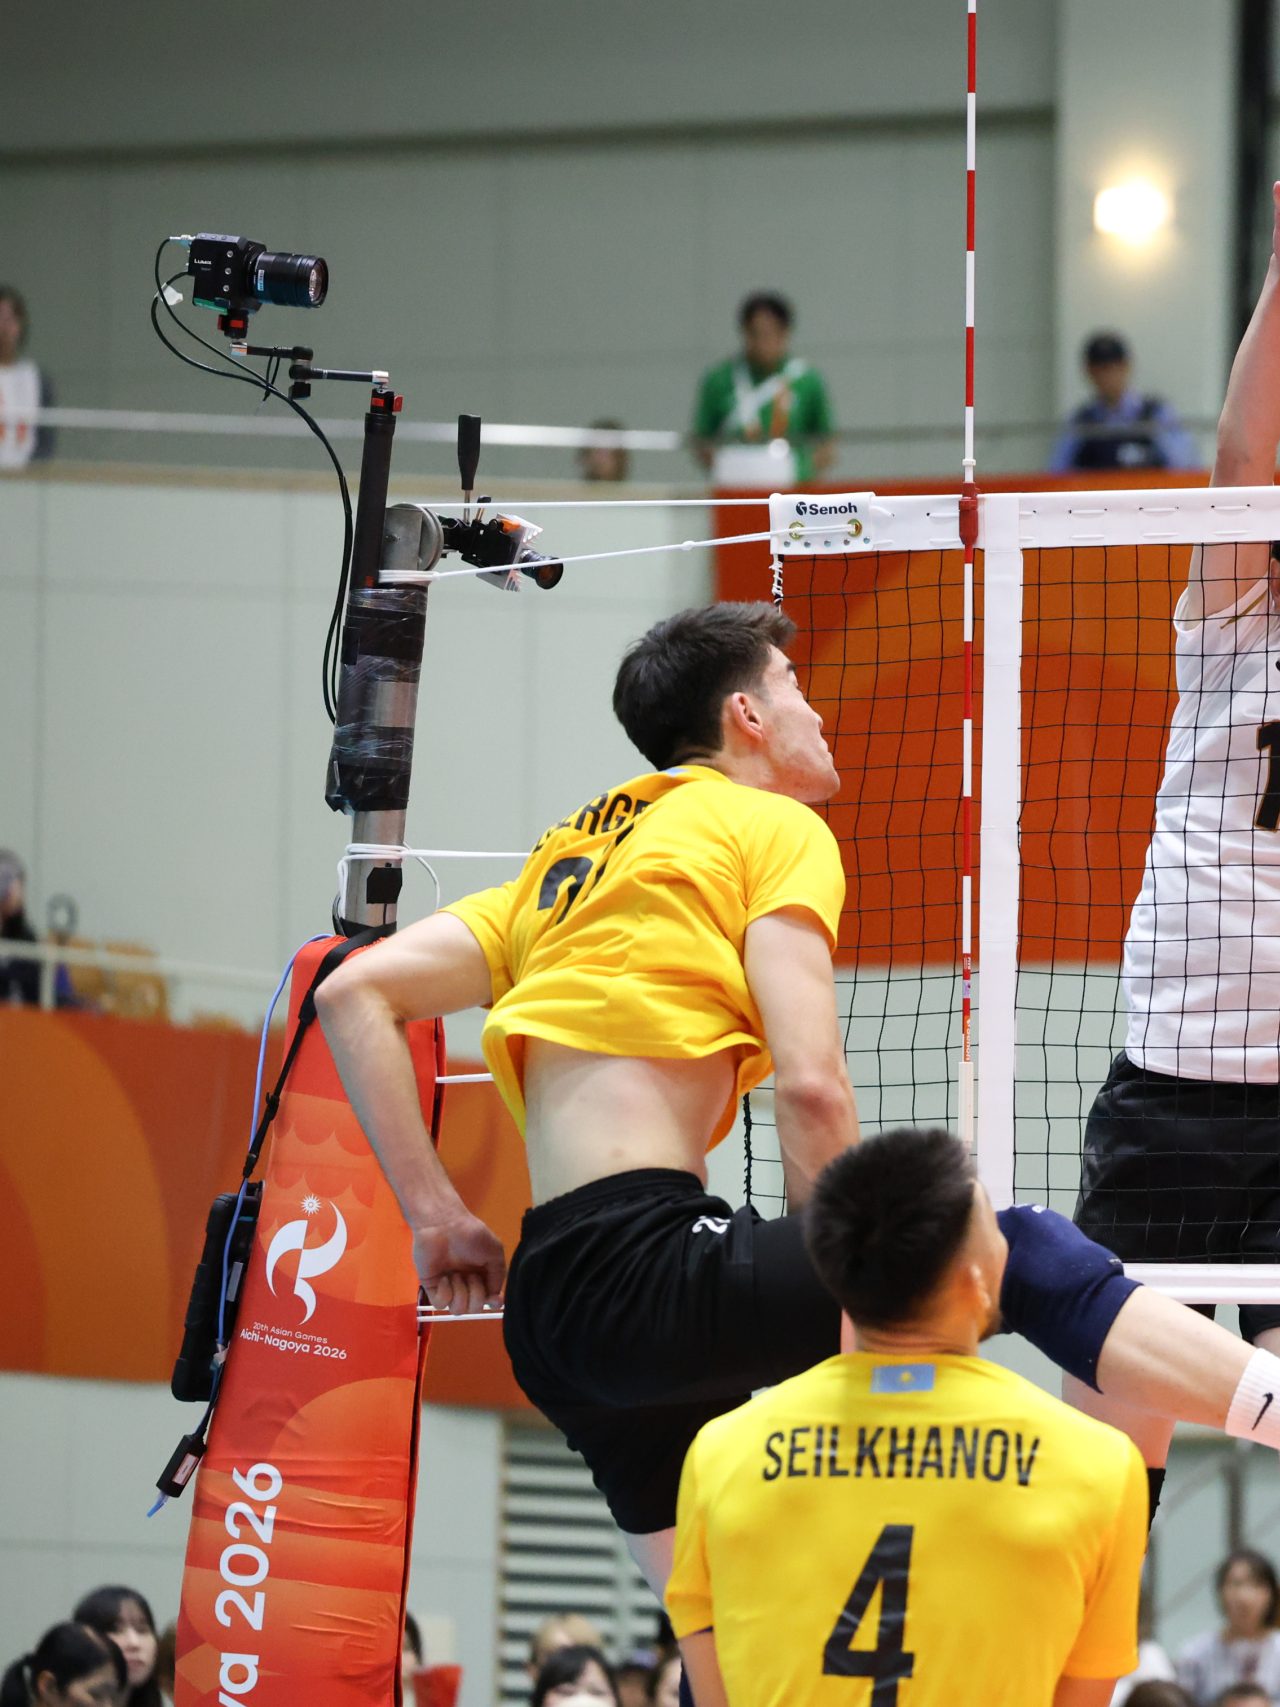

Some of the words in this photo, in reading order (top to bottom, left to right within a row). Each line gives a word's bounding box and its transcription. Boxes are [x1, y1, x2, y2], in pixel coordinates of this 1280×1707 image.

[809, 502, 858, 516] Senoh
[240, 1328, 311, 1354] Aichi-Nagoya
[313, 1344, 348, 1360] 2026
[252, 1321, 269, 1332] 20th
[270, 1326, 293, 1337] Asian
[294, 1331, 328, 1344] Games
[762, 1425, 1041, 1487] SEILKHANOV
[214, 1462, 283, 1631] 2026
[821, 1523, 915, 1707] 4
